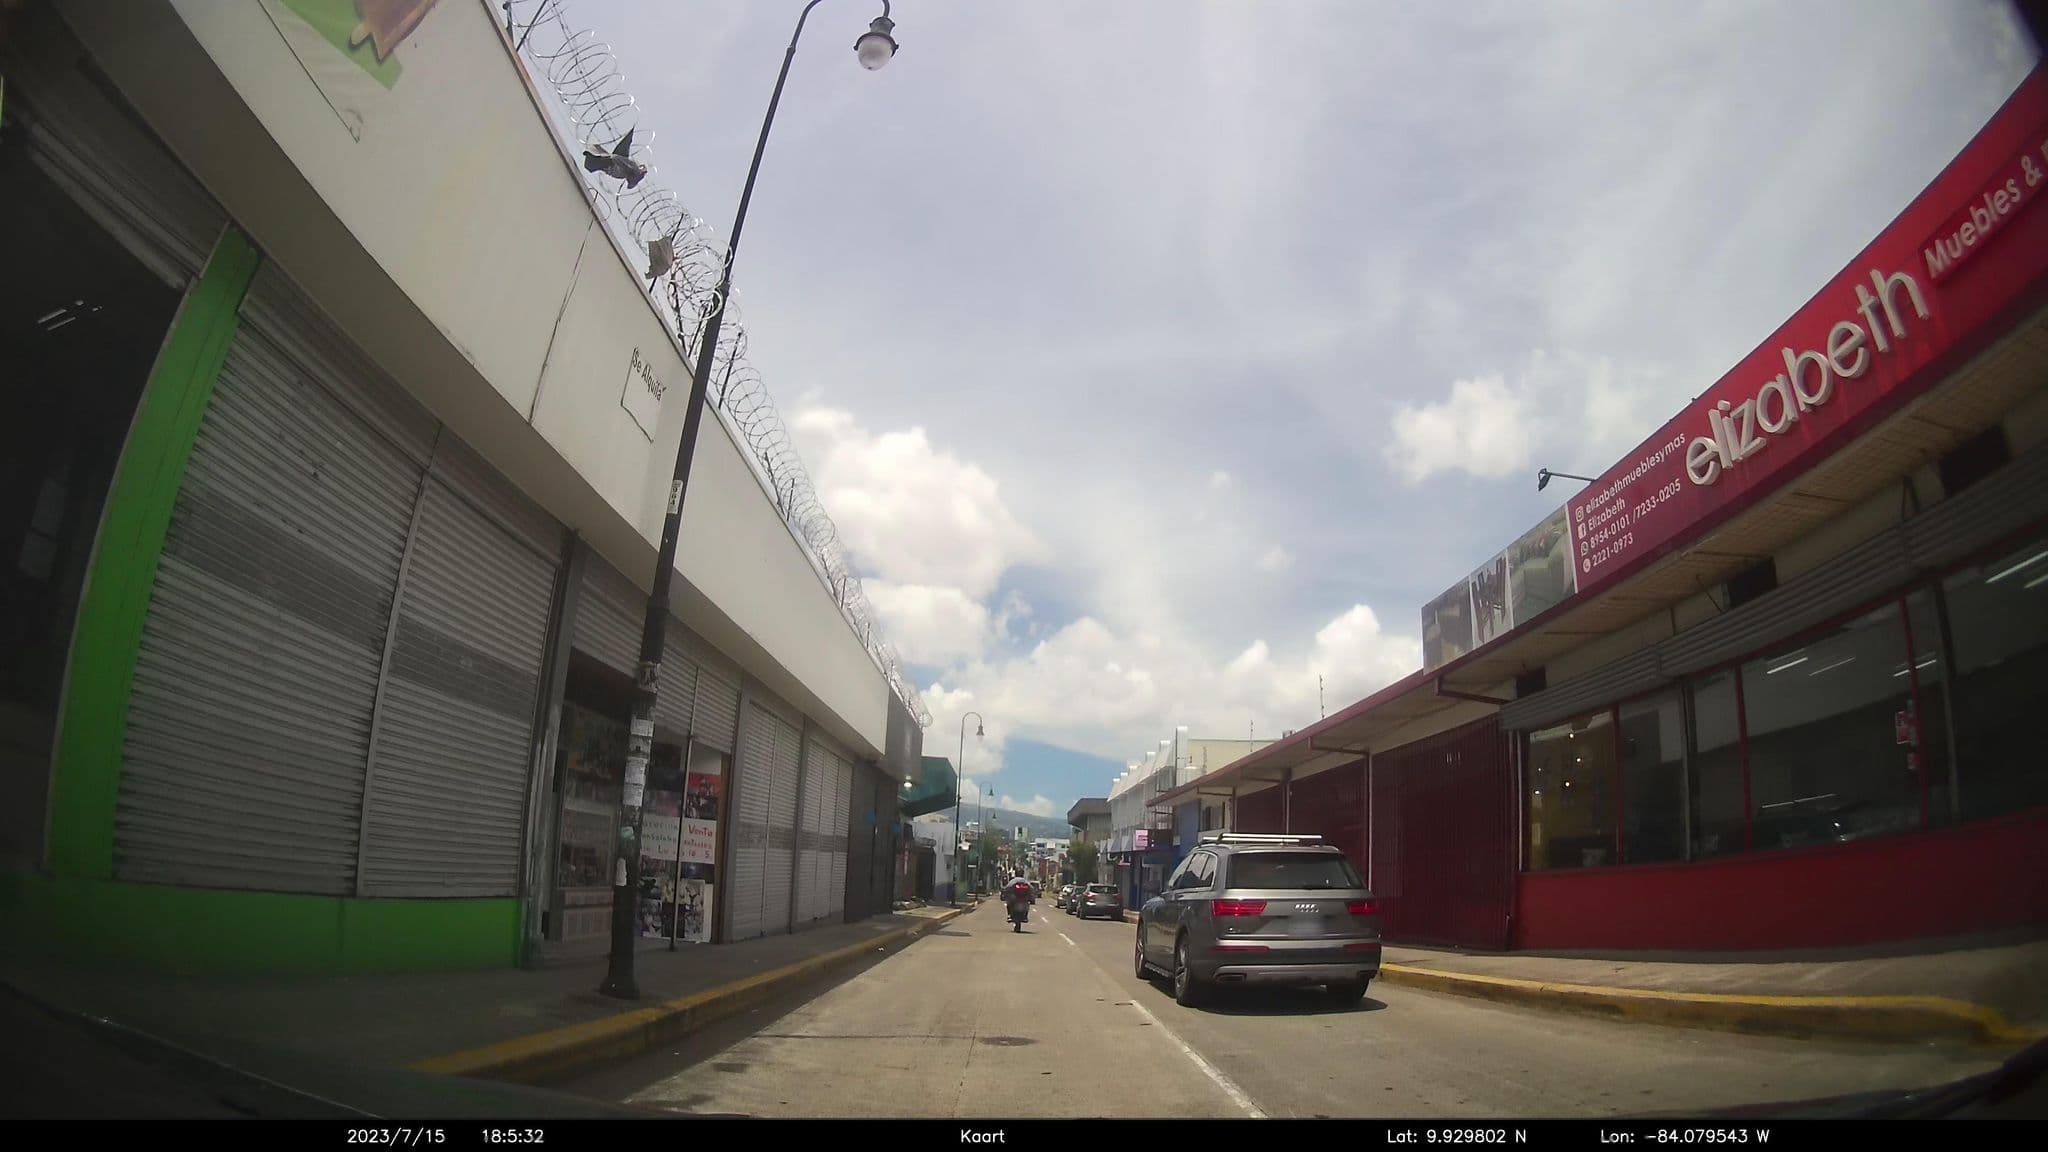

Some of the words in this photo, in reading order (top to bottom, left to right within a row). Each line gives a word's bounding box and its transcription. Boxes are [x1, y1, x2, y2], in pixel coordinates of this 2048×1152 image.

[1924, 178, 2021, 279] Muebles
[2021, 155, 2043, 187] &
[641, 363, 663, 401] Alquila
[1686, 269, 1930, 486] elizabeth
[1585, 433, 1686, 514] elizabethmueblesymas
[1587, 498, 1626, 531] Elizabeth
[1590, 515, 1631, 549] 8954-0101
[1592, 532, 1634, 567] 2221-0973
